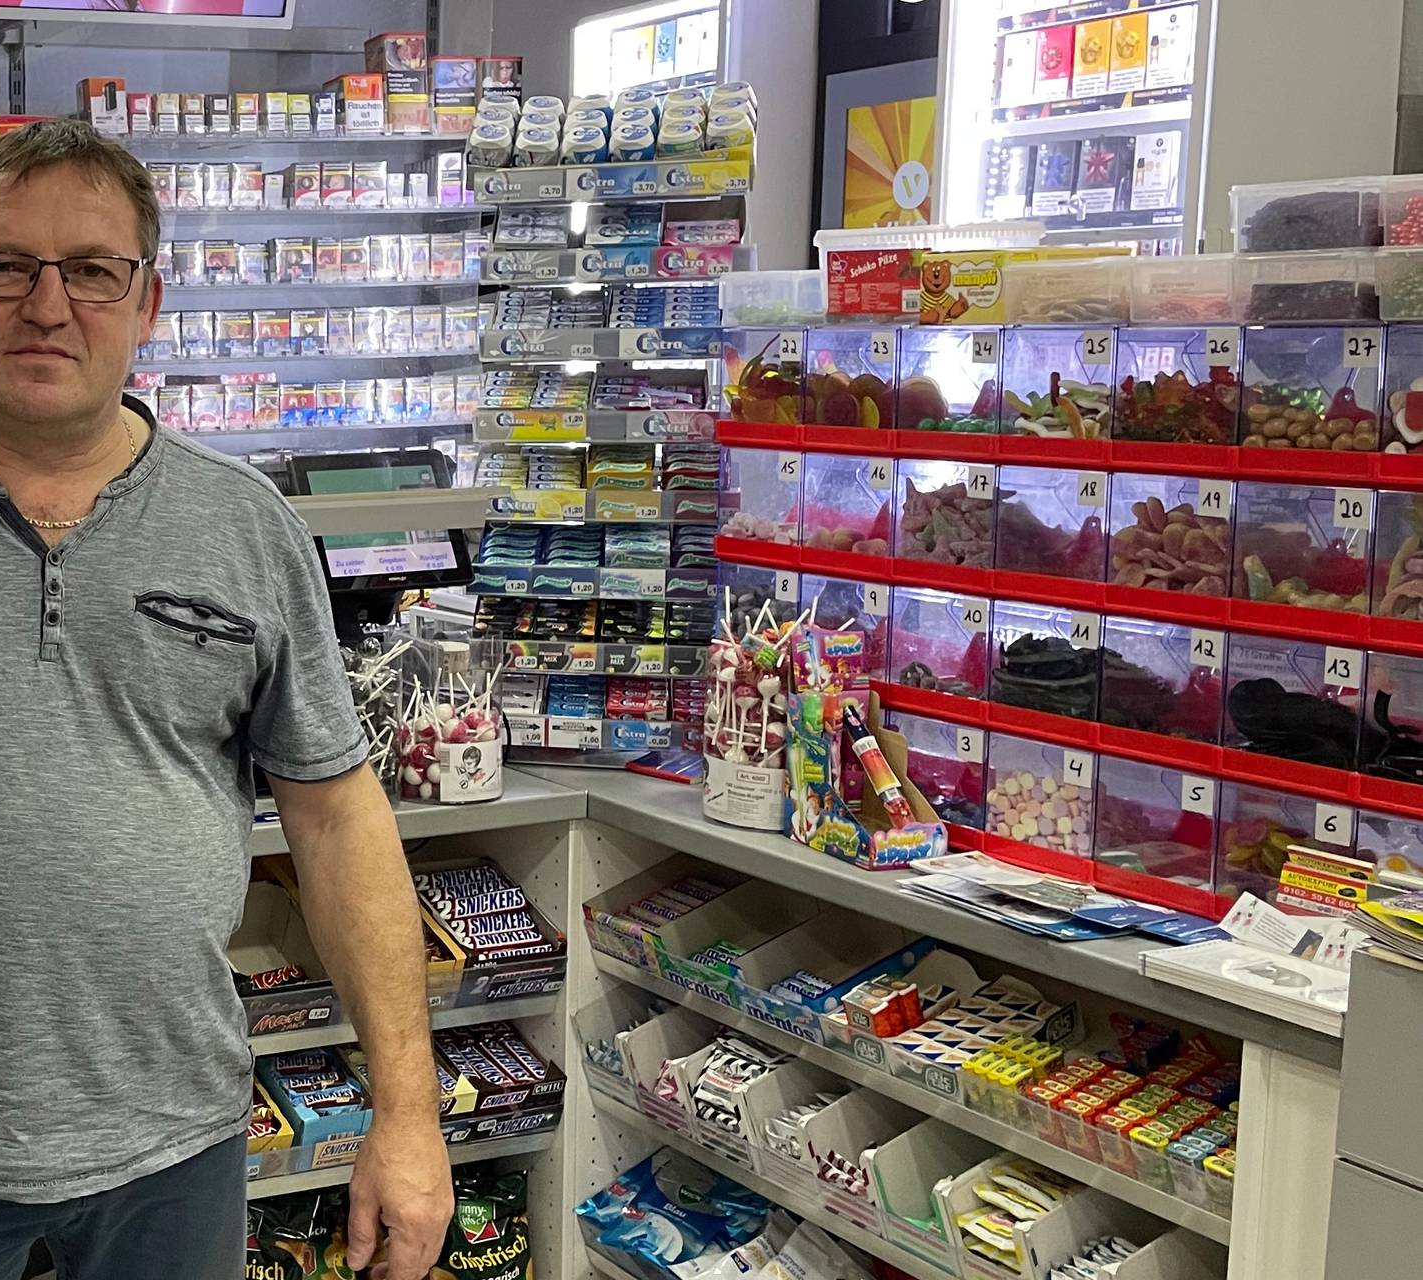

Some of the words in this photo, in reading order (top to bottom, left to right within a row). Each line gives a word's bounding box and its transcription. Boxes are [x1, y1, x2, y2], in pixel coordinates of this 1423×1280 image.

[489, 173, 521, 193] Extra
[585, 172, 615, 190] Extra
[673, 169, 705, 186] Extra
[728, 177, 747, 188] 3,70
[498, 256, 532, 273] Extra
[590, 255, 622, 271] Extra
[667, 256, 705, 271] Extra
[850, 260, 877, 278] Schoko
[878, 253, 898, 268] Pilze
[506, 338, 545, 353] Extra
[645, 337, 683, 352] Extra
[781, 338, 798, 355] 22
[872, 340, 889, 355] 23
[974, 341, 993, 357] 24
[1085, 337, 1109, 354] 25
[1210, 339, 1231, 354] 26
[1348, 337, 1377, 357] 27
[781, 461, 796, 475] 15
[871, 465, 886, 480] 16
[969, 474, 989, 492] 17
[1080, 480, 1097, 498] 18
[497, 498, 537, 513] Extra
[1202, 491, 1222, 509] 19
[1339, 500, 1364, 519] 20
[780, 578, 789, 593] 8
[869, 591, 877, 606] 9
[963, 609, 983, 624] 10
[1071, 623, 1090, 640] 11
[1193, 638, 1216, 658] 12
[1327, 658, 1351, 679] 13
[961, 736, 972, 752] 3
[1069, 757, 1084, 777] 4
[1189, 786, 1206, 801] 5
[1323, 815, 1337, 833] 6
[414, 874, 429, 891] 2
[434, 866, 498, 888] SNICKERS
[1287, 872, 1338, 889] AUTOEXPORT
[437, 900, 452, 920] 2
[457, 888, 525, 916] SNICKERS
[451, 920, 466, 938] 2
[470, 911, 534, 935] SNICKERS
[668, 970, 731, 1006] mentos
[746, 1003, 816, 1042] mentos
[306, 1089, 353, 1103] SNICKERS
[483, 1092, 527, 1106] SNICKERS
[493, 1113, 544, 1132] SNICKERS
[322, 1140, 361, 1157] SNICKER
[449, 1233, 528, 1271] Chipsfrisch
